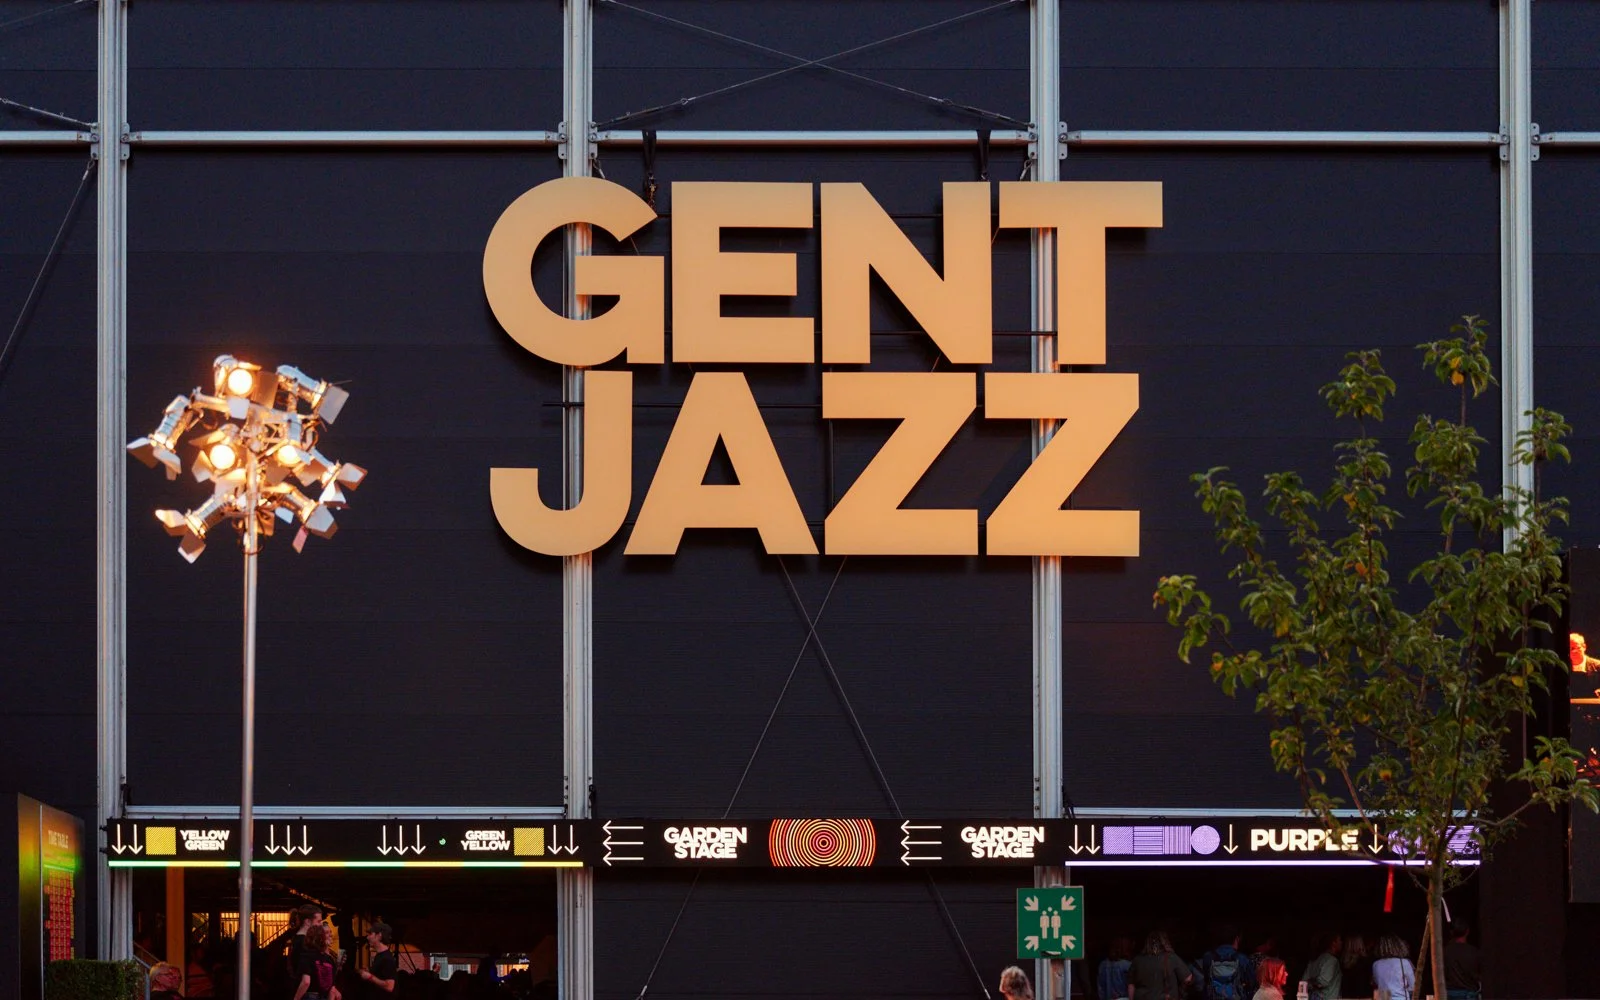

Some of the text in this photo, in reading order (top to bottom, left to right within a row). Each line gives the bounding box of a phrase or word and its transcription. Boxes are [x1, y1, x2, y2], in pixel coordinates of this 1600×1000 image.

[482, 177, 1163, 366] GENT
[490, 370, 1140, 557] JAZZ
[180, 829, 230, 840] YELLOW
[465, 830, 505, 840] GREEN
[664, 826, 747, 843] GARDEN
[961, 826, 1044, 843] GARDEN
[1250, 828, 1359, 851] PURPLE
[185, 839, 226, 850] GREEN
[460, 840, 510, 850] YELLOW
[674, 842, 738, 859] STAGE
[971, 842, 1035, 858] STAGE
